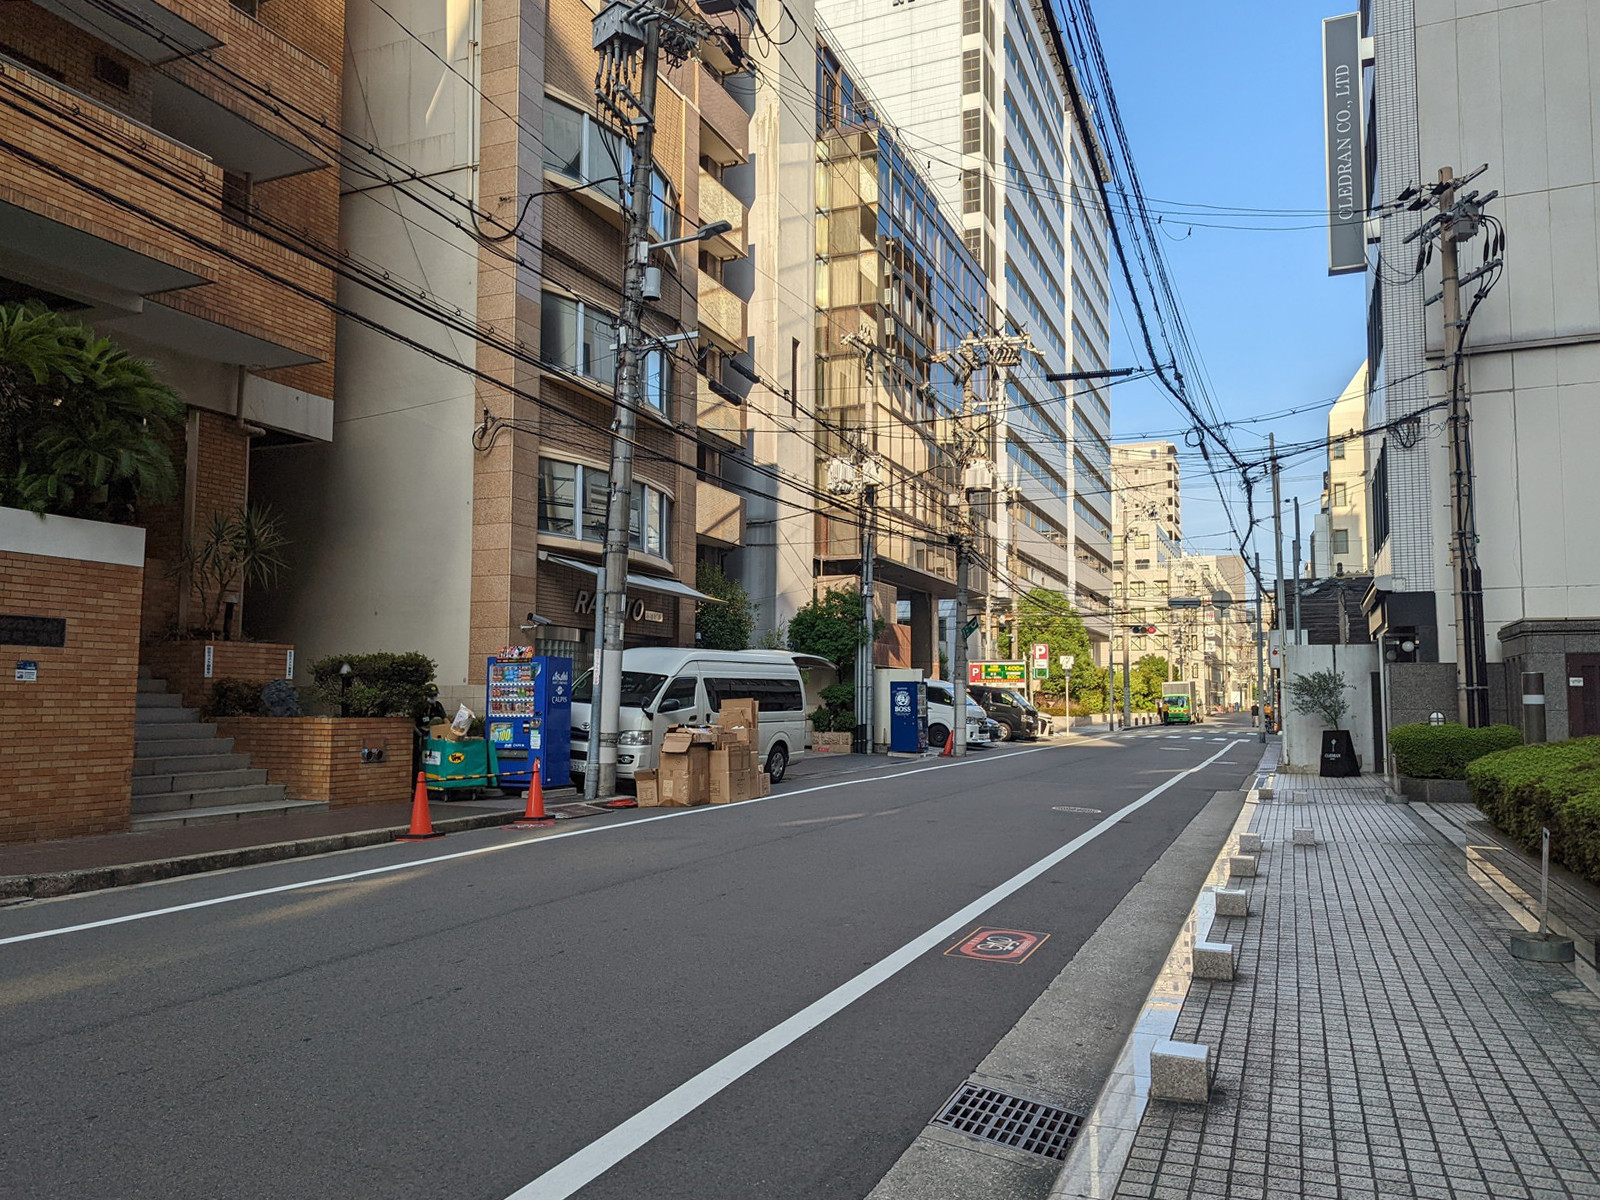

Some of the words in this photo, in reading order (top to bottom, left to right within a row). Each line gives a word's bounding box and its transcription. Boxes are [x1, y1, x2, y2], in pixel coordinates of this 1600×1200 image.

[1335, 64, 1350, 97] LTD
[1336, 100, 1353, 133] CO.,
[1337, 139, 1354, 220] CLEDRAN
[1035, 645, 1046, 659] P
[972, 667, 980, 677] P
[551, 696, 568, 704] CALPIS
